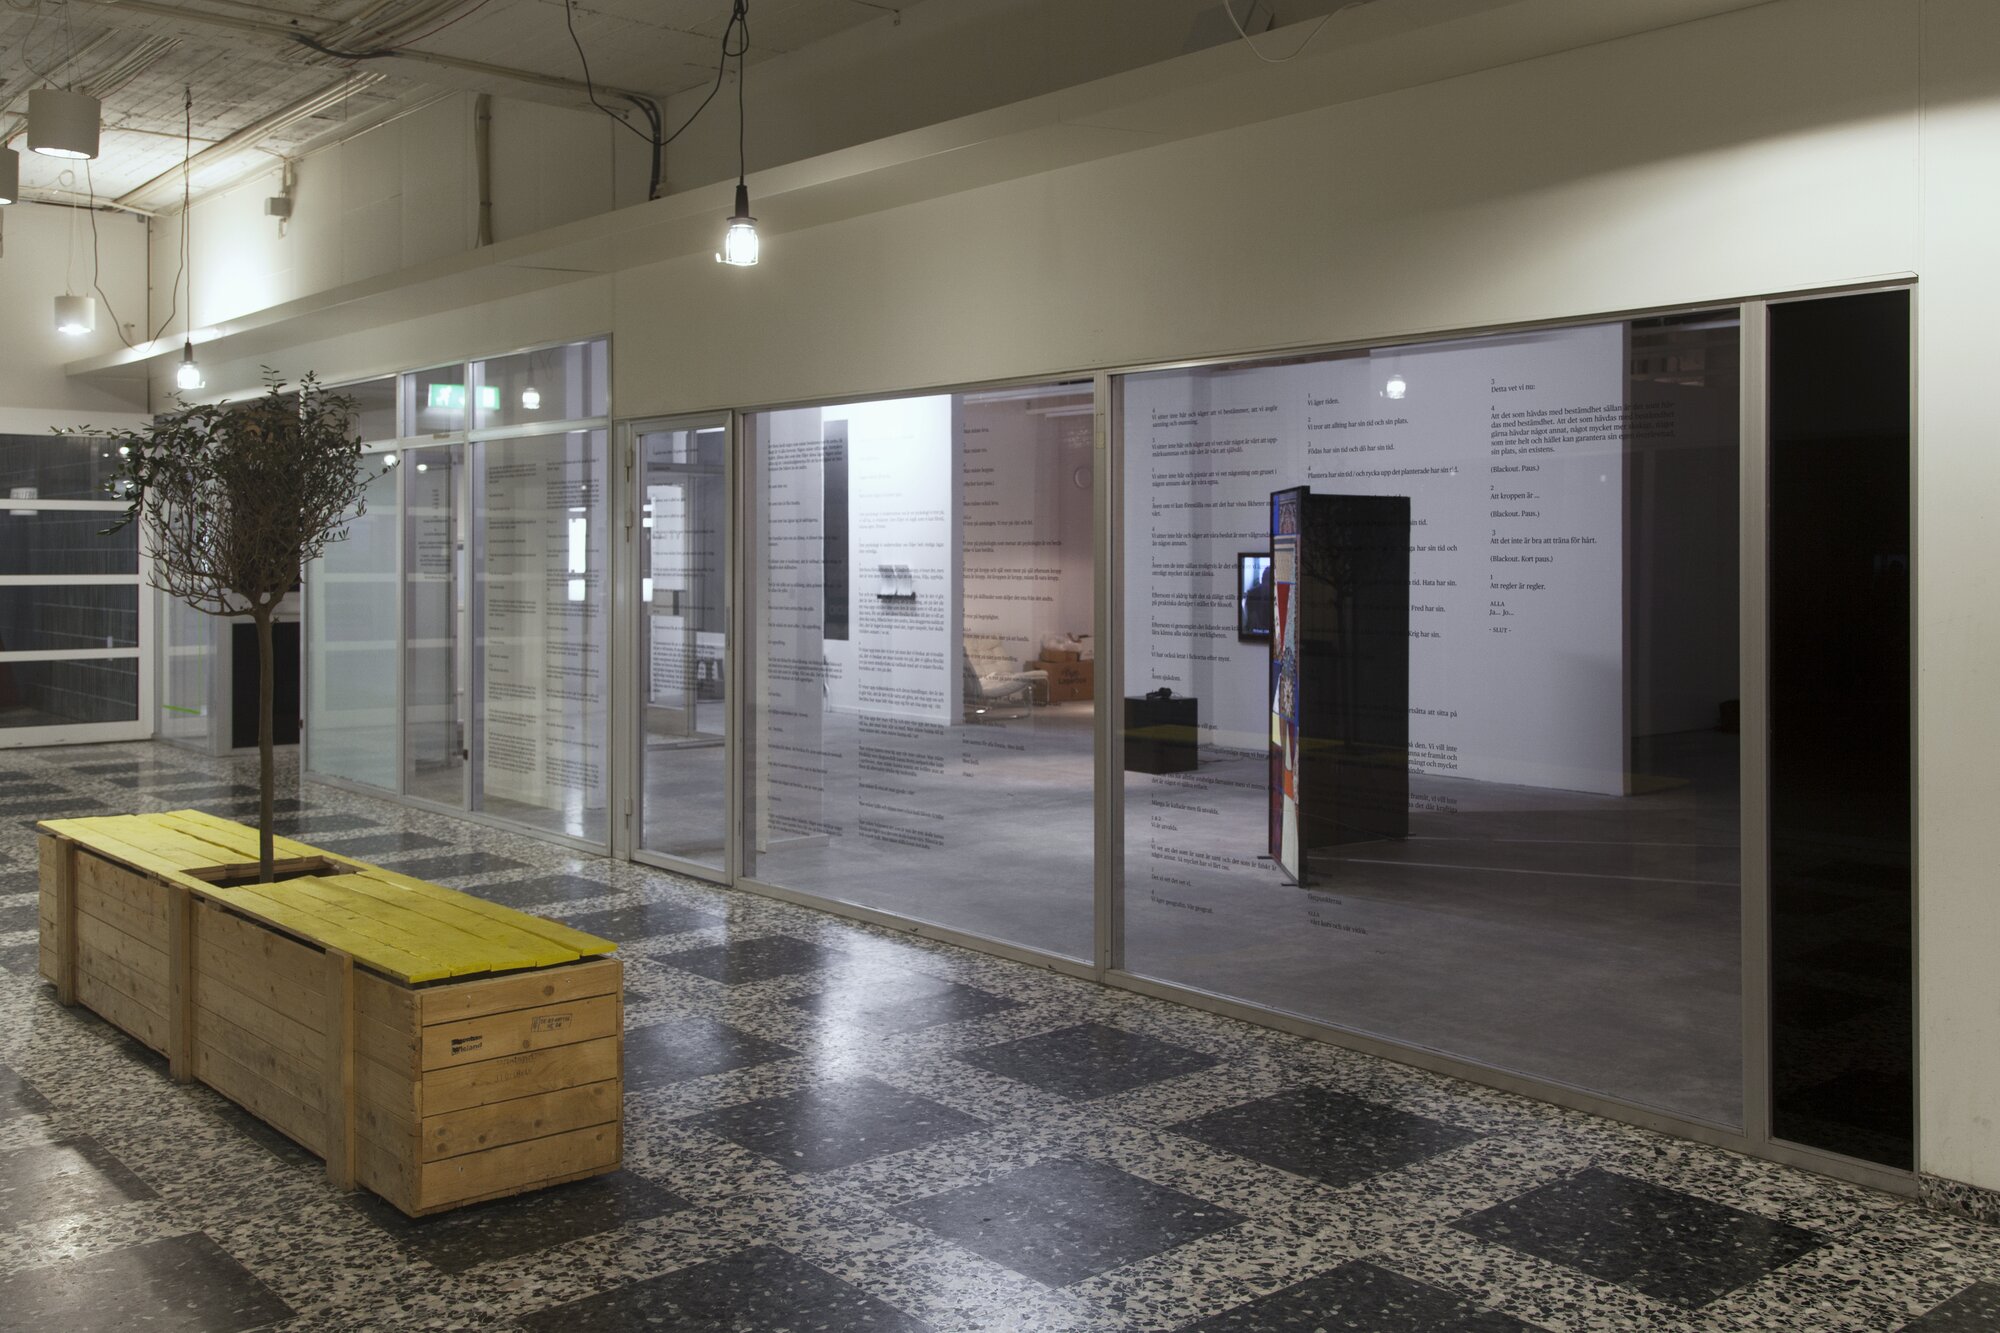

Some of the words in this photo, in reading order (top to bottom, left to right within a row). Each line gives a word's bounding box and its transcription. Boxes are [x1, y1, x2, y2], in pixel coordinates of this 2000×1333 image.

[1564, 406, 1602, 414] bestämdhet
[1332, 422, 1347, 430] allting
[1394, 418, 1408, 426] plats.
[1517, 418, 1554, 427] bestämdhet.
[1491, 430, 1508, 438] gärna
[1530, 428, 1547, 436] något
[1570, 426, 1587, 434] något
[1589, 424, 1612, 433] mycket
[1575, 435, 1606, 443] garantera
[1501, 448, 1517, 456] plats,
[1491, 466, 1520, 474] (Blackout.
[1500, 583, 1517, 591] regler
[1526, 583, 1546, 591] regler.
[1450, 710, 1458, 718] på
[1437, 761, 1458, 771] mycket
